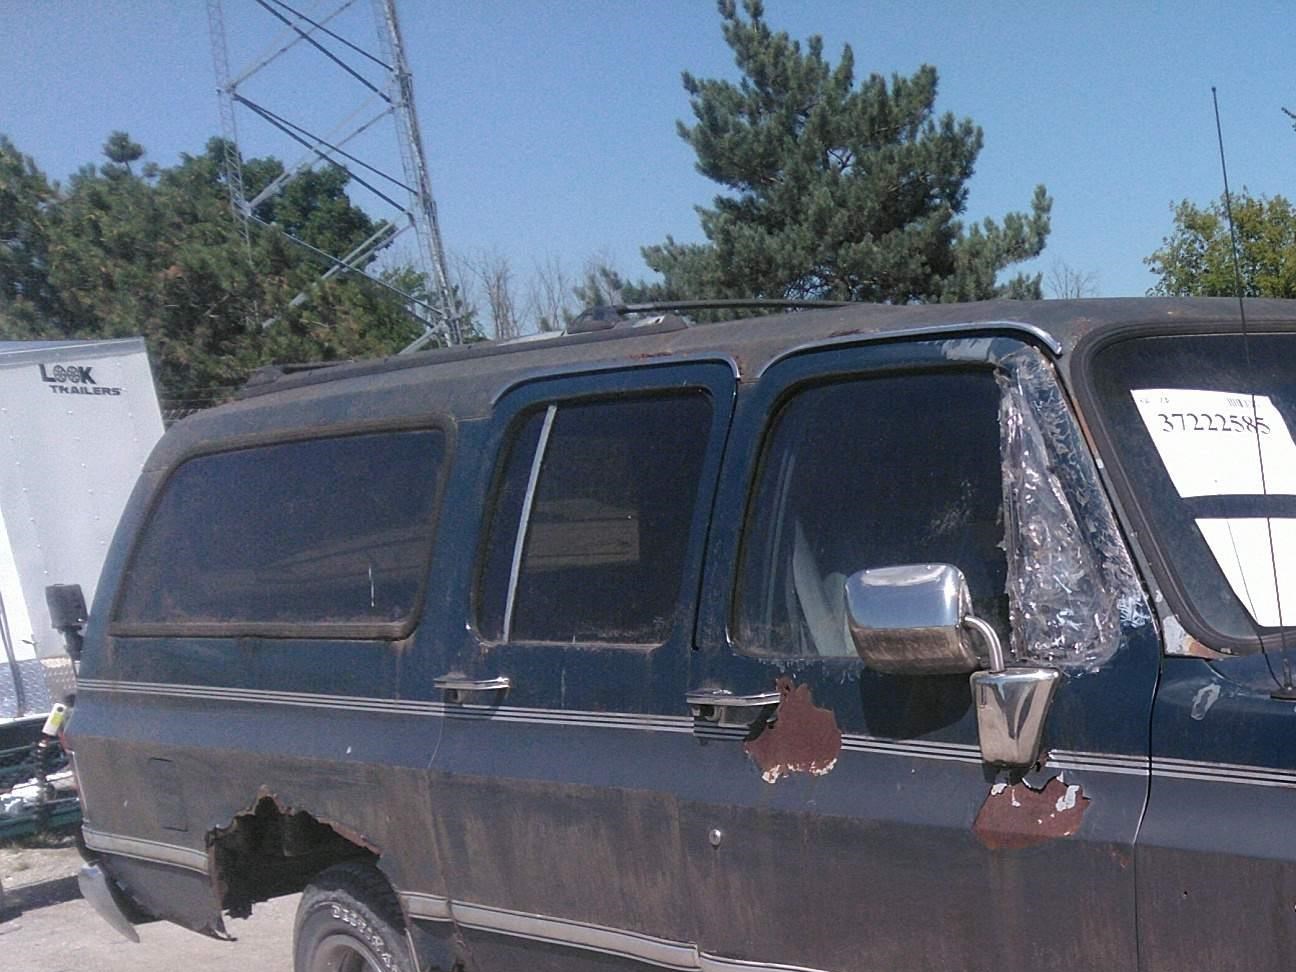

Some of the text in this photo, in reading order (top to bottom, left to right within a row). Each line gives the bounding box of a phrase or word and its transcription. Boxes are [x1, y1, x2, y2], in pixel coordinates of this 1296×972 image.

[38, 363, 96, 385] LOOK
[50, 384, 122, 396] TRAILERS
[1157, 412, 1271, 435] 37222585
